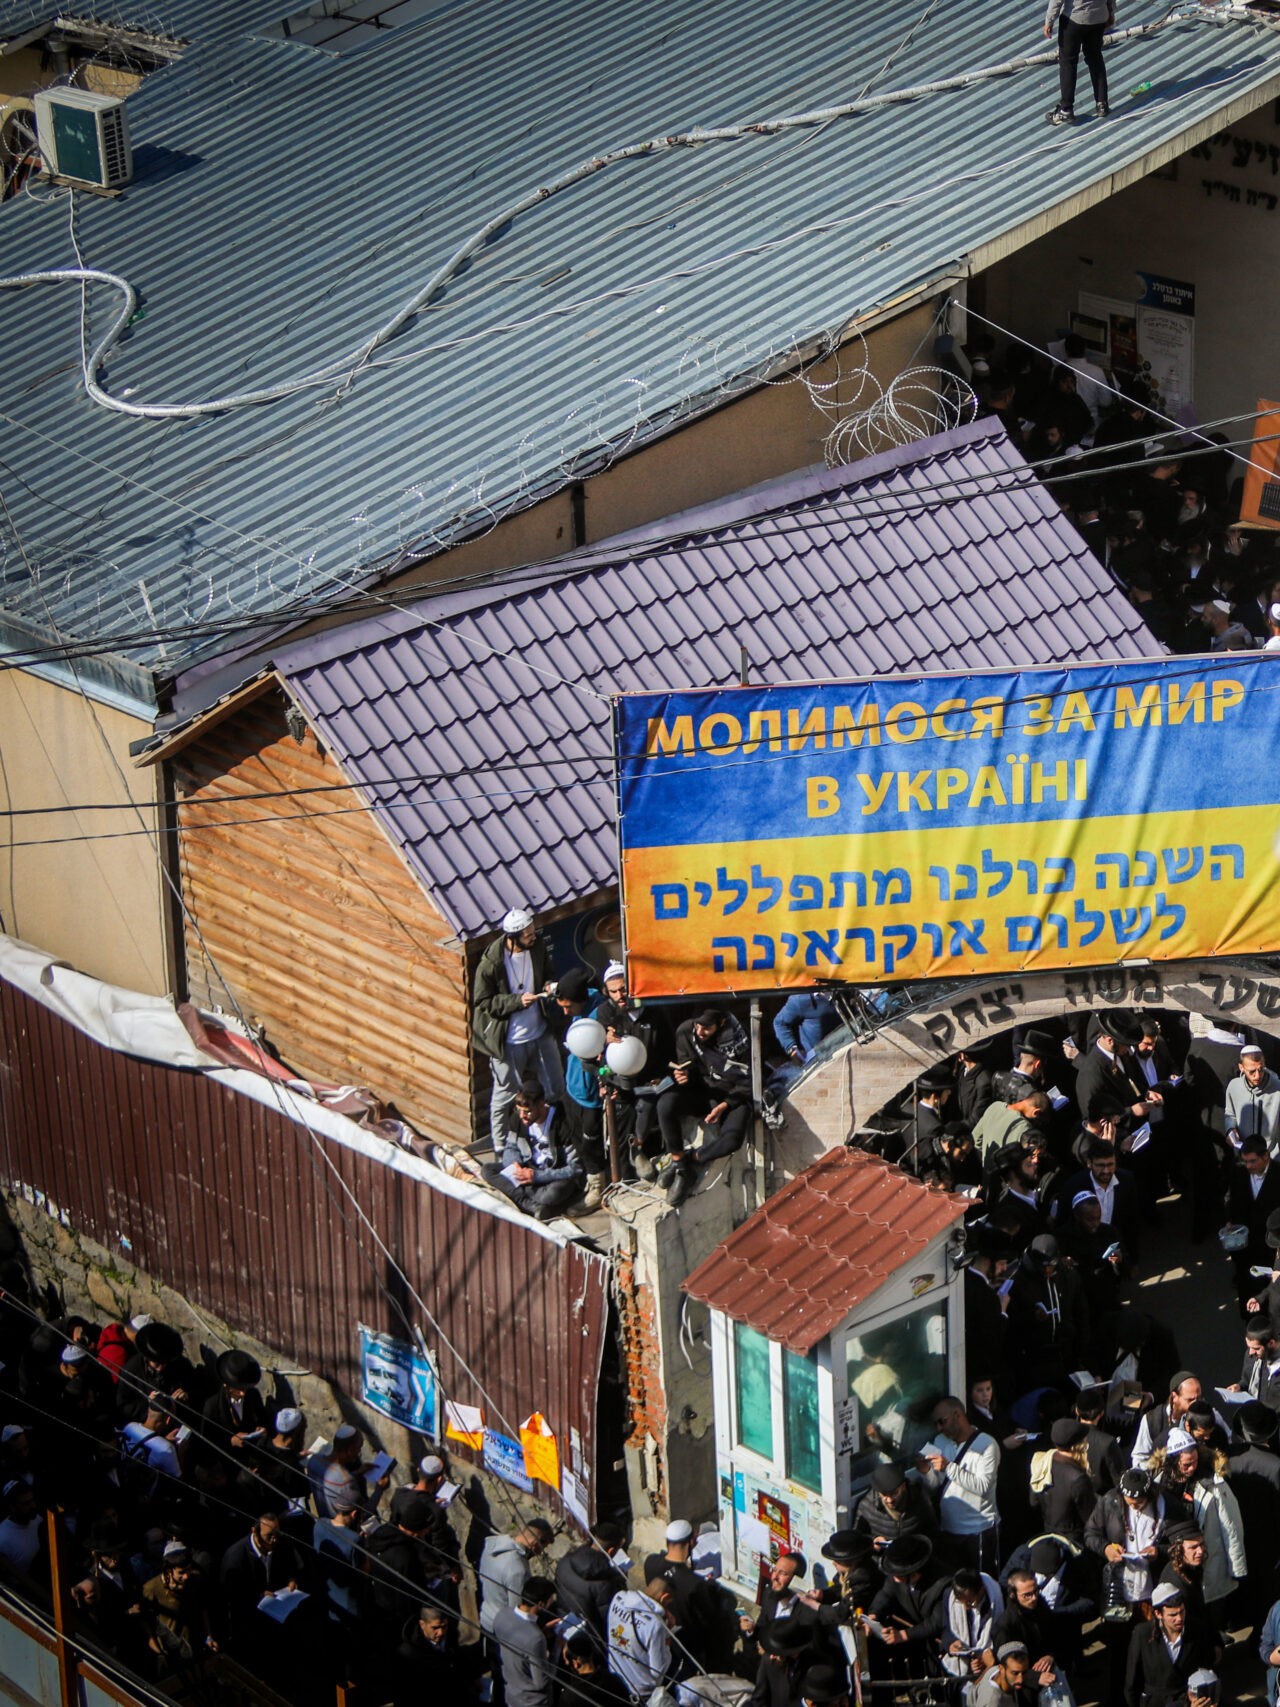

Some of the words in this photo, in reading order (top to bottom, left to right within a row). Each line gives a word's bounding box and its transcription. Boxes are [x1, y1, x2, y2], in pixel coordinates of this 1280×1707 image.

[646, 696, 1004, 760] МОЛИМОСЯ
[1022, 691, 1096, 737] ЗА
[1114, 679, 1245, 729] МИР
[806, 775, 841, 819] В
[856, 753, 1087, 816] УКРАЇНІ
[650, 864, 912, 921] מתפללים
[929, 848, 1077, 902] כולנו
[1095, 843, 1244, 890] השנה
[712, 919, 988, 974] אוקראינה
[1004, 892, 1186, 952] לשלום
[1064, 967, 1164, 1005] משה
[923, 983, 1024, 1049] יצחק
[841, 1438, 853, 1449] WC
